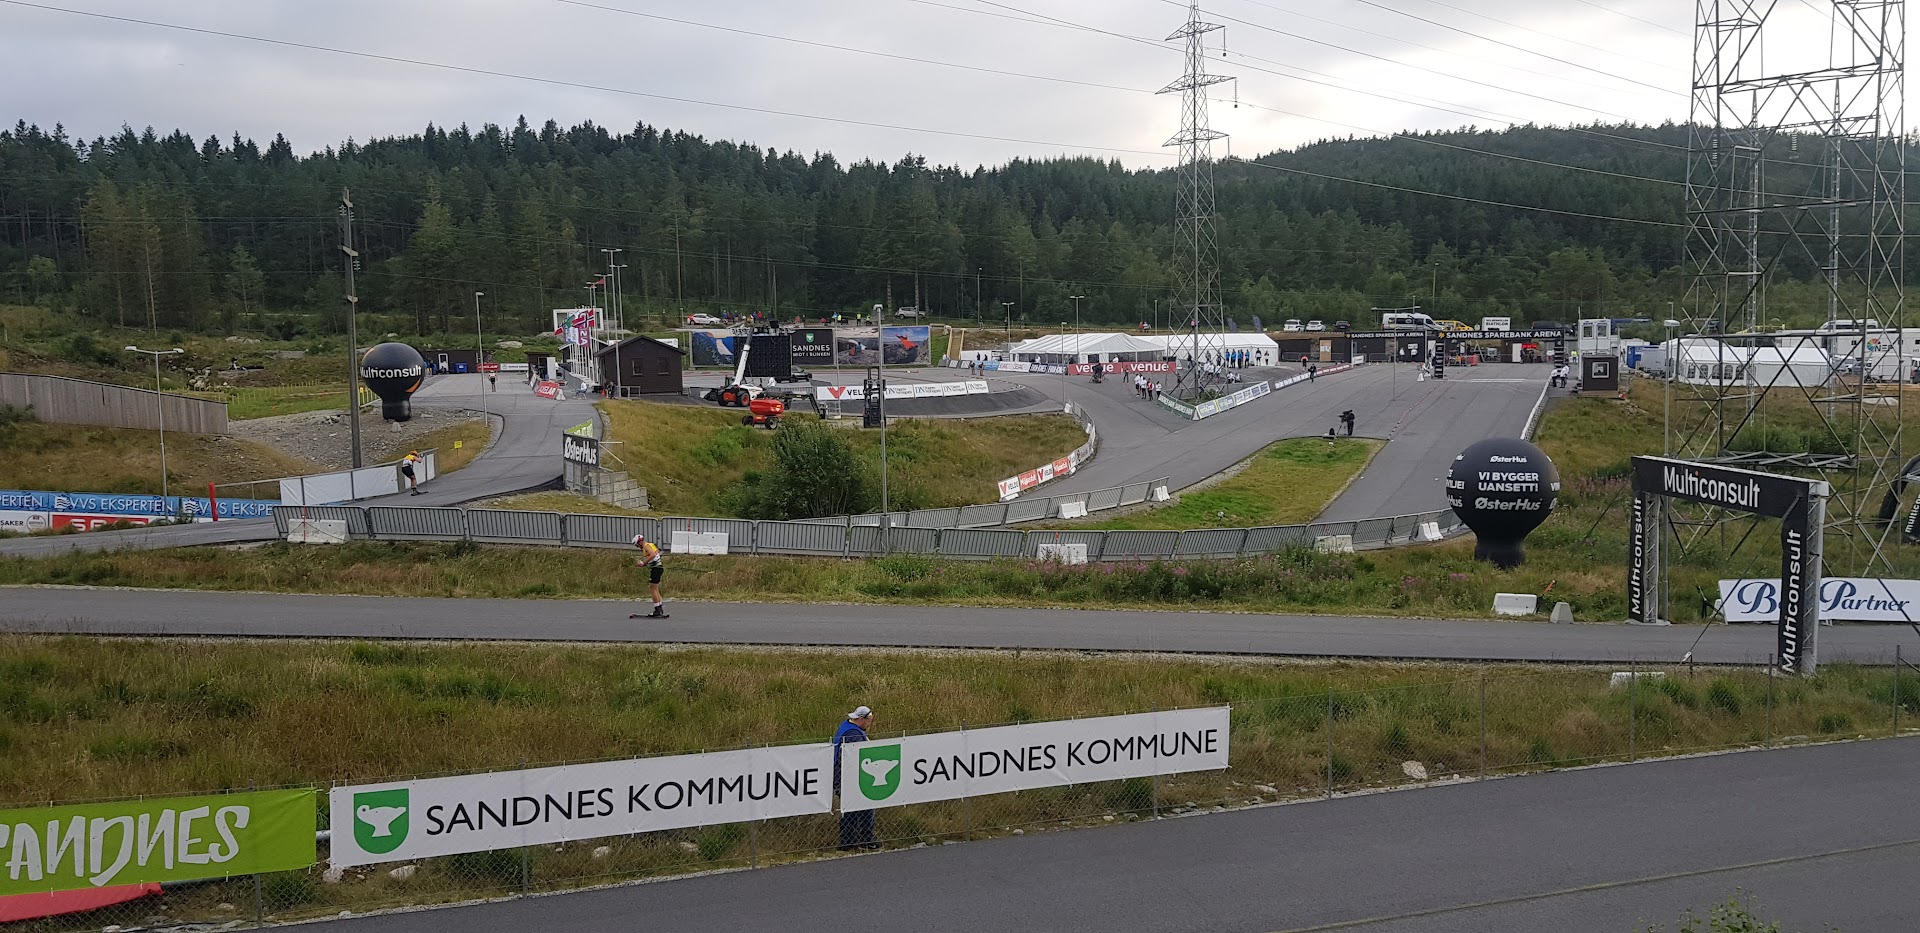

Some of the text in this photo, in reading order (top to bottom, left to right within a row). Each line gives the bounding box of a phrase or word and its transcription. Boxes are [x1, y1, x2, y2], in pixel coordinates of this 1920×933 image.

[1075, 363, 1114, 373] vee
[1130, 362, 1169, 371] venue
[564, 436, 597, 464] ØsterHus
[1490, 455, 1527, 463] ØsterHus
[1479, 471, 1539, 482] VI BYGGER
[1478, 482, 1539, 492] UANSETT!
[1664, 465, 1760, 508] Multiconsult
[70, 497, 173, 512] VVS EKSPERTEN
[201, 503, 227, 515] VS
[1474, 497, 1542, 510] ØsterHus
[1631, 497, 1642, 615] Multiconsult
[1782, 529, 1801, 673] Multiconsult
[913, 729, 1218, 785] SANDNES KOMMUNE
[426, 768, 819, 836] SANDNES KOMMUNE
